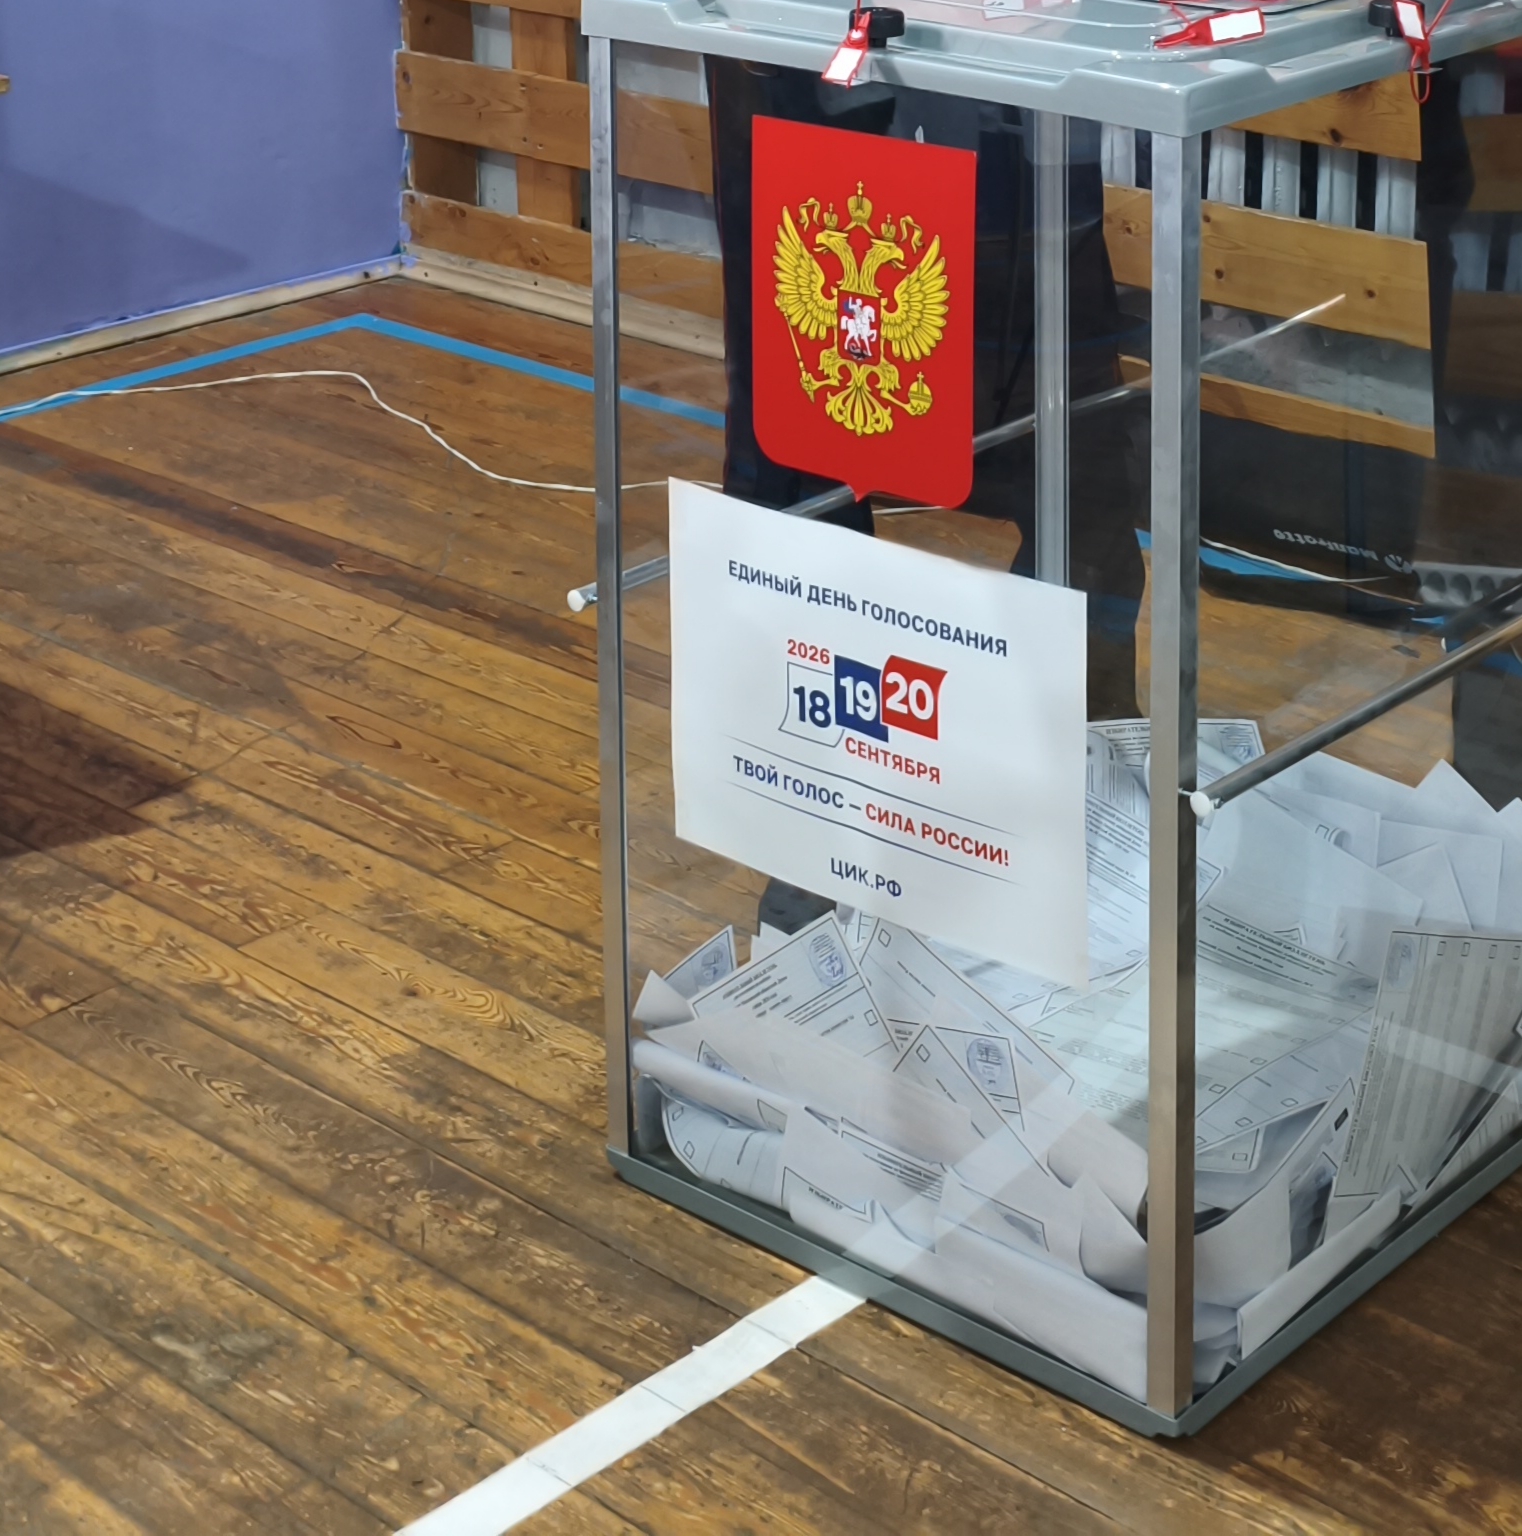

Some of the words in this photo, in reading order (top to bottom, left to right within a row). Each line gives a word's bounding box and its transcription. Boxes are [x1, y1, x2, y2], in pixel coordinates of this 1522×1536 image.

[1273, 528, 1379, 562] Manfrotto
[728, 559, 802, 599] ЕДИНЫЙ
[806, 584, 858, 613] ДЕНЬ
[861, 599, 1008, 658] ГОЛОСОВАНИЯ
[786, 638, 831, 665] 2026
[792, 685, 832, 729] 18
[838, 675, 878, 722] 19
[884, 671, 935, 720] 20
[845, 737, 941, 784] СЕНТЯБРЯ
[733, 755, 779, 787] ТВОЙ
[783, 774, 844, 809] ГОЛОС
[865, 802, 916, 837] СИЛА
[921, 821, 1010, 867] РОССИИ!
[829, 856, 902, 898] ЦИК.РФ
